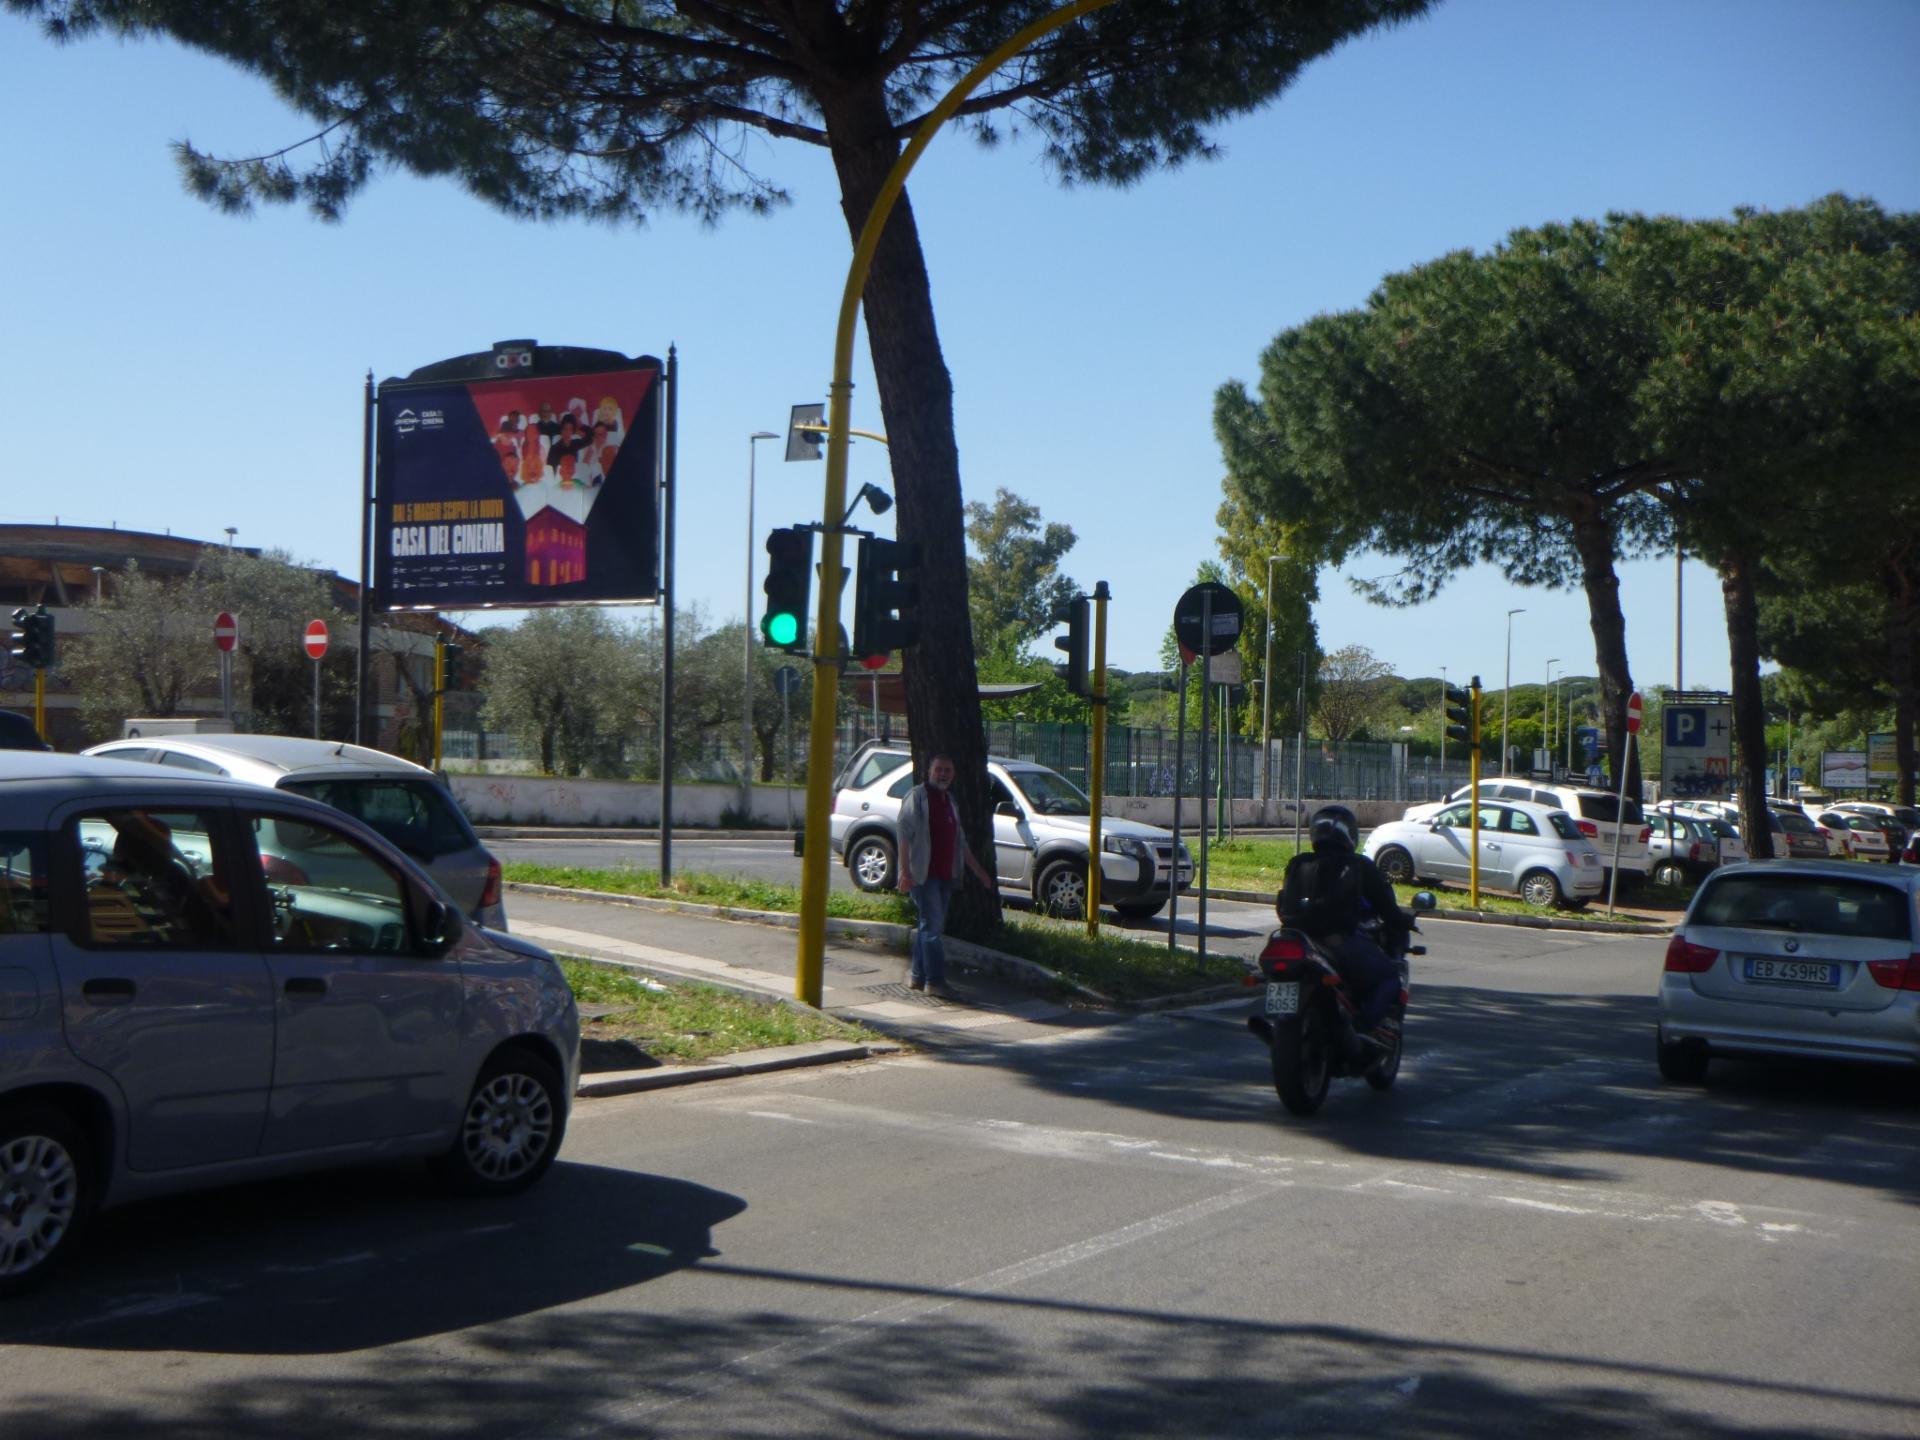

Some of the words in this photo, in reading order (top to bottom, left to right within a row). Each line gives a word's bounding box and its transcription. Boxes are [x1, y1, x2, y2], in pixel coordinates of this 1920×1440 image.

[392, 526, 427, 557] CASA
[429, 525, 450, 555] DEL
[452, 523, 505, 554] CINEMA
[1676, 713, 1695, 741] P
[1755, 961, 1774, 976] EB
[1779, 963, 1828, 981] 459HS
[1267, 998, 1297, 1011] 6053
